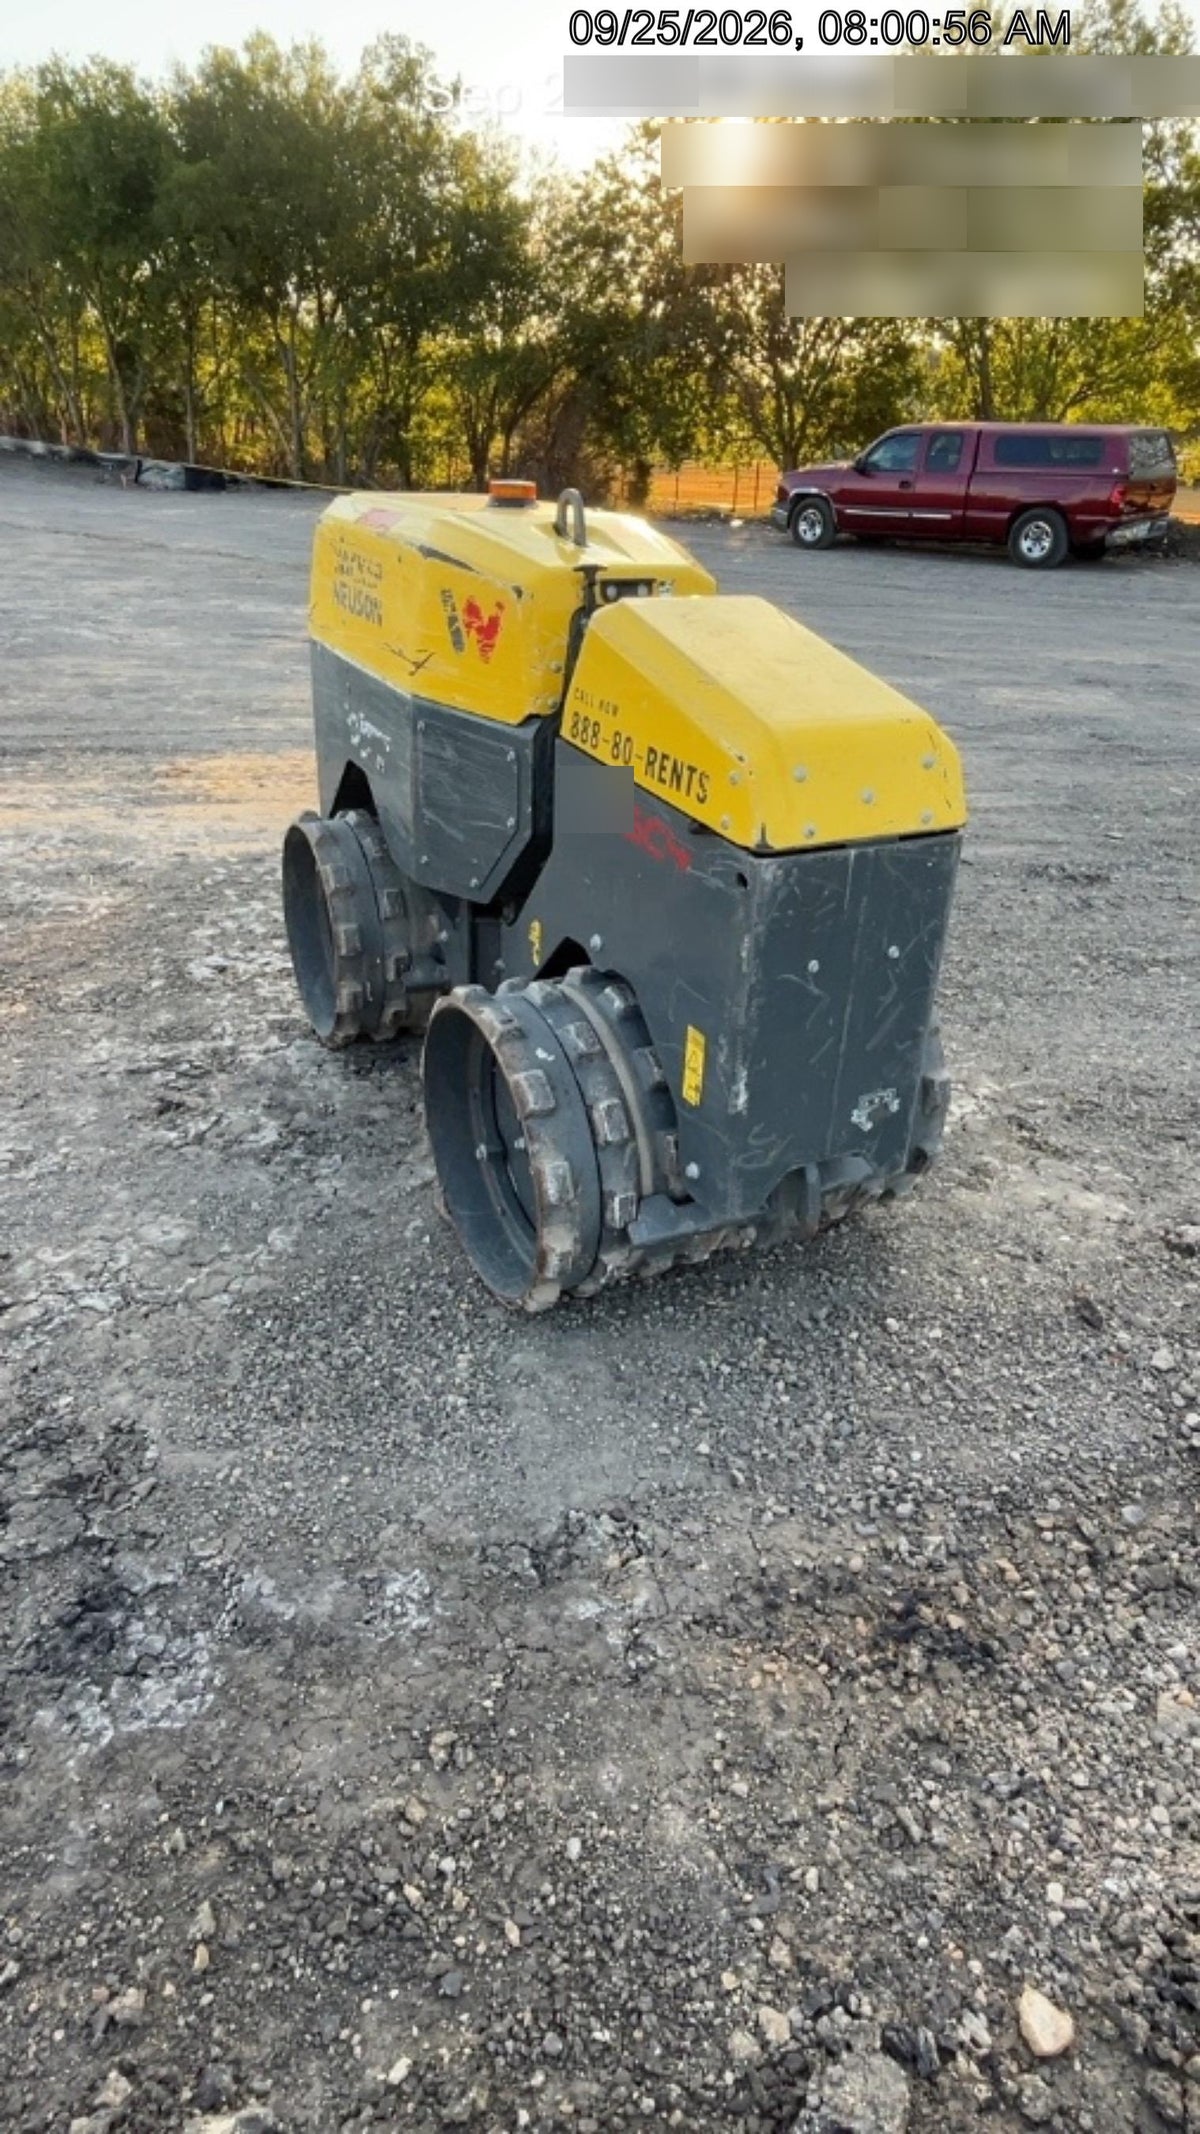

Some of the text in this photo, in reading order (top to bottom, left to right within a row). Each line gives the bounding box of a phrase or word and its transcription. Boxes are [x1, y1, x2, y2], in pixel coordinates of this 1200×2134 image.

[574, 687, 620, 718] CALL NOW
[570, 710, 711, 805] 888-80-RENTS
